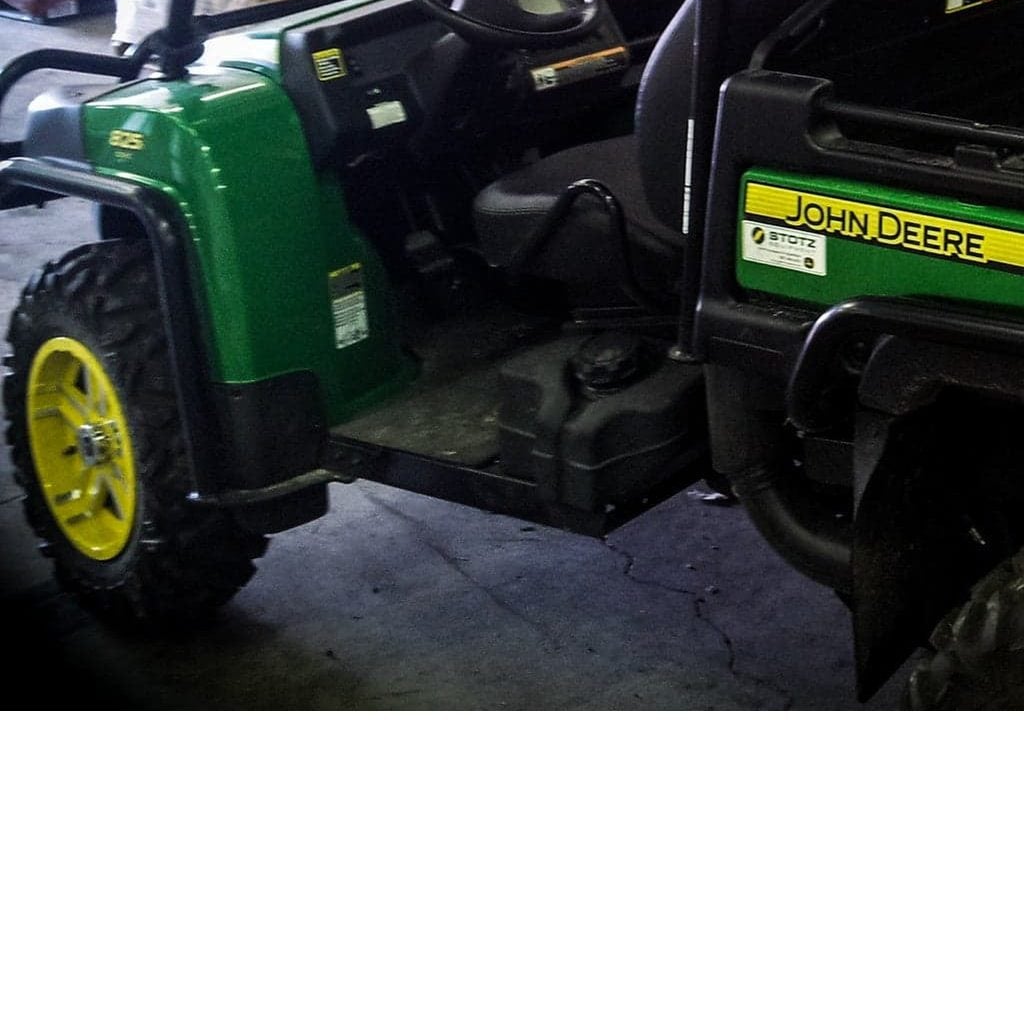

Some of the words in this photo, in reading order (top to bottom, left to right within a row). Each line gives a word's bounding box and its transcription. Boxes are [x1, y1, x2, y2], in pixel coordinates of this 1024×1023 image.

[769, 231, 816, 248] STOTZ
[786, 195, 869, 237] JOHN
[877, 210, 985, 259] DEERE
